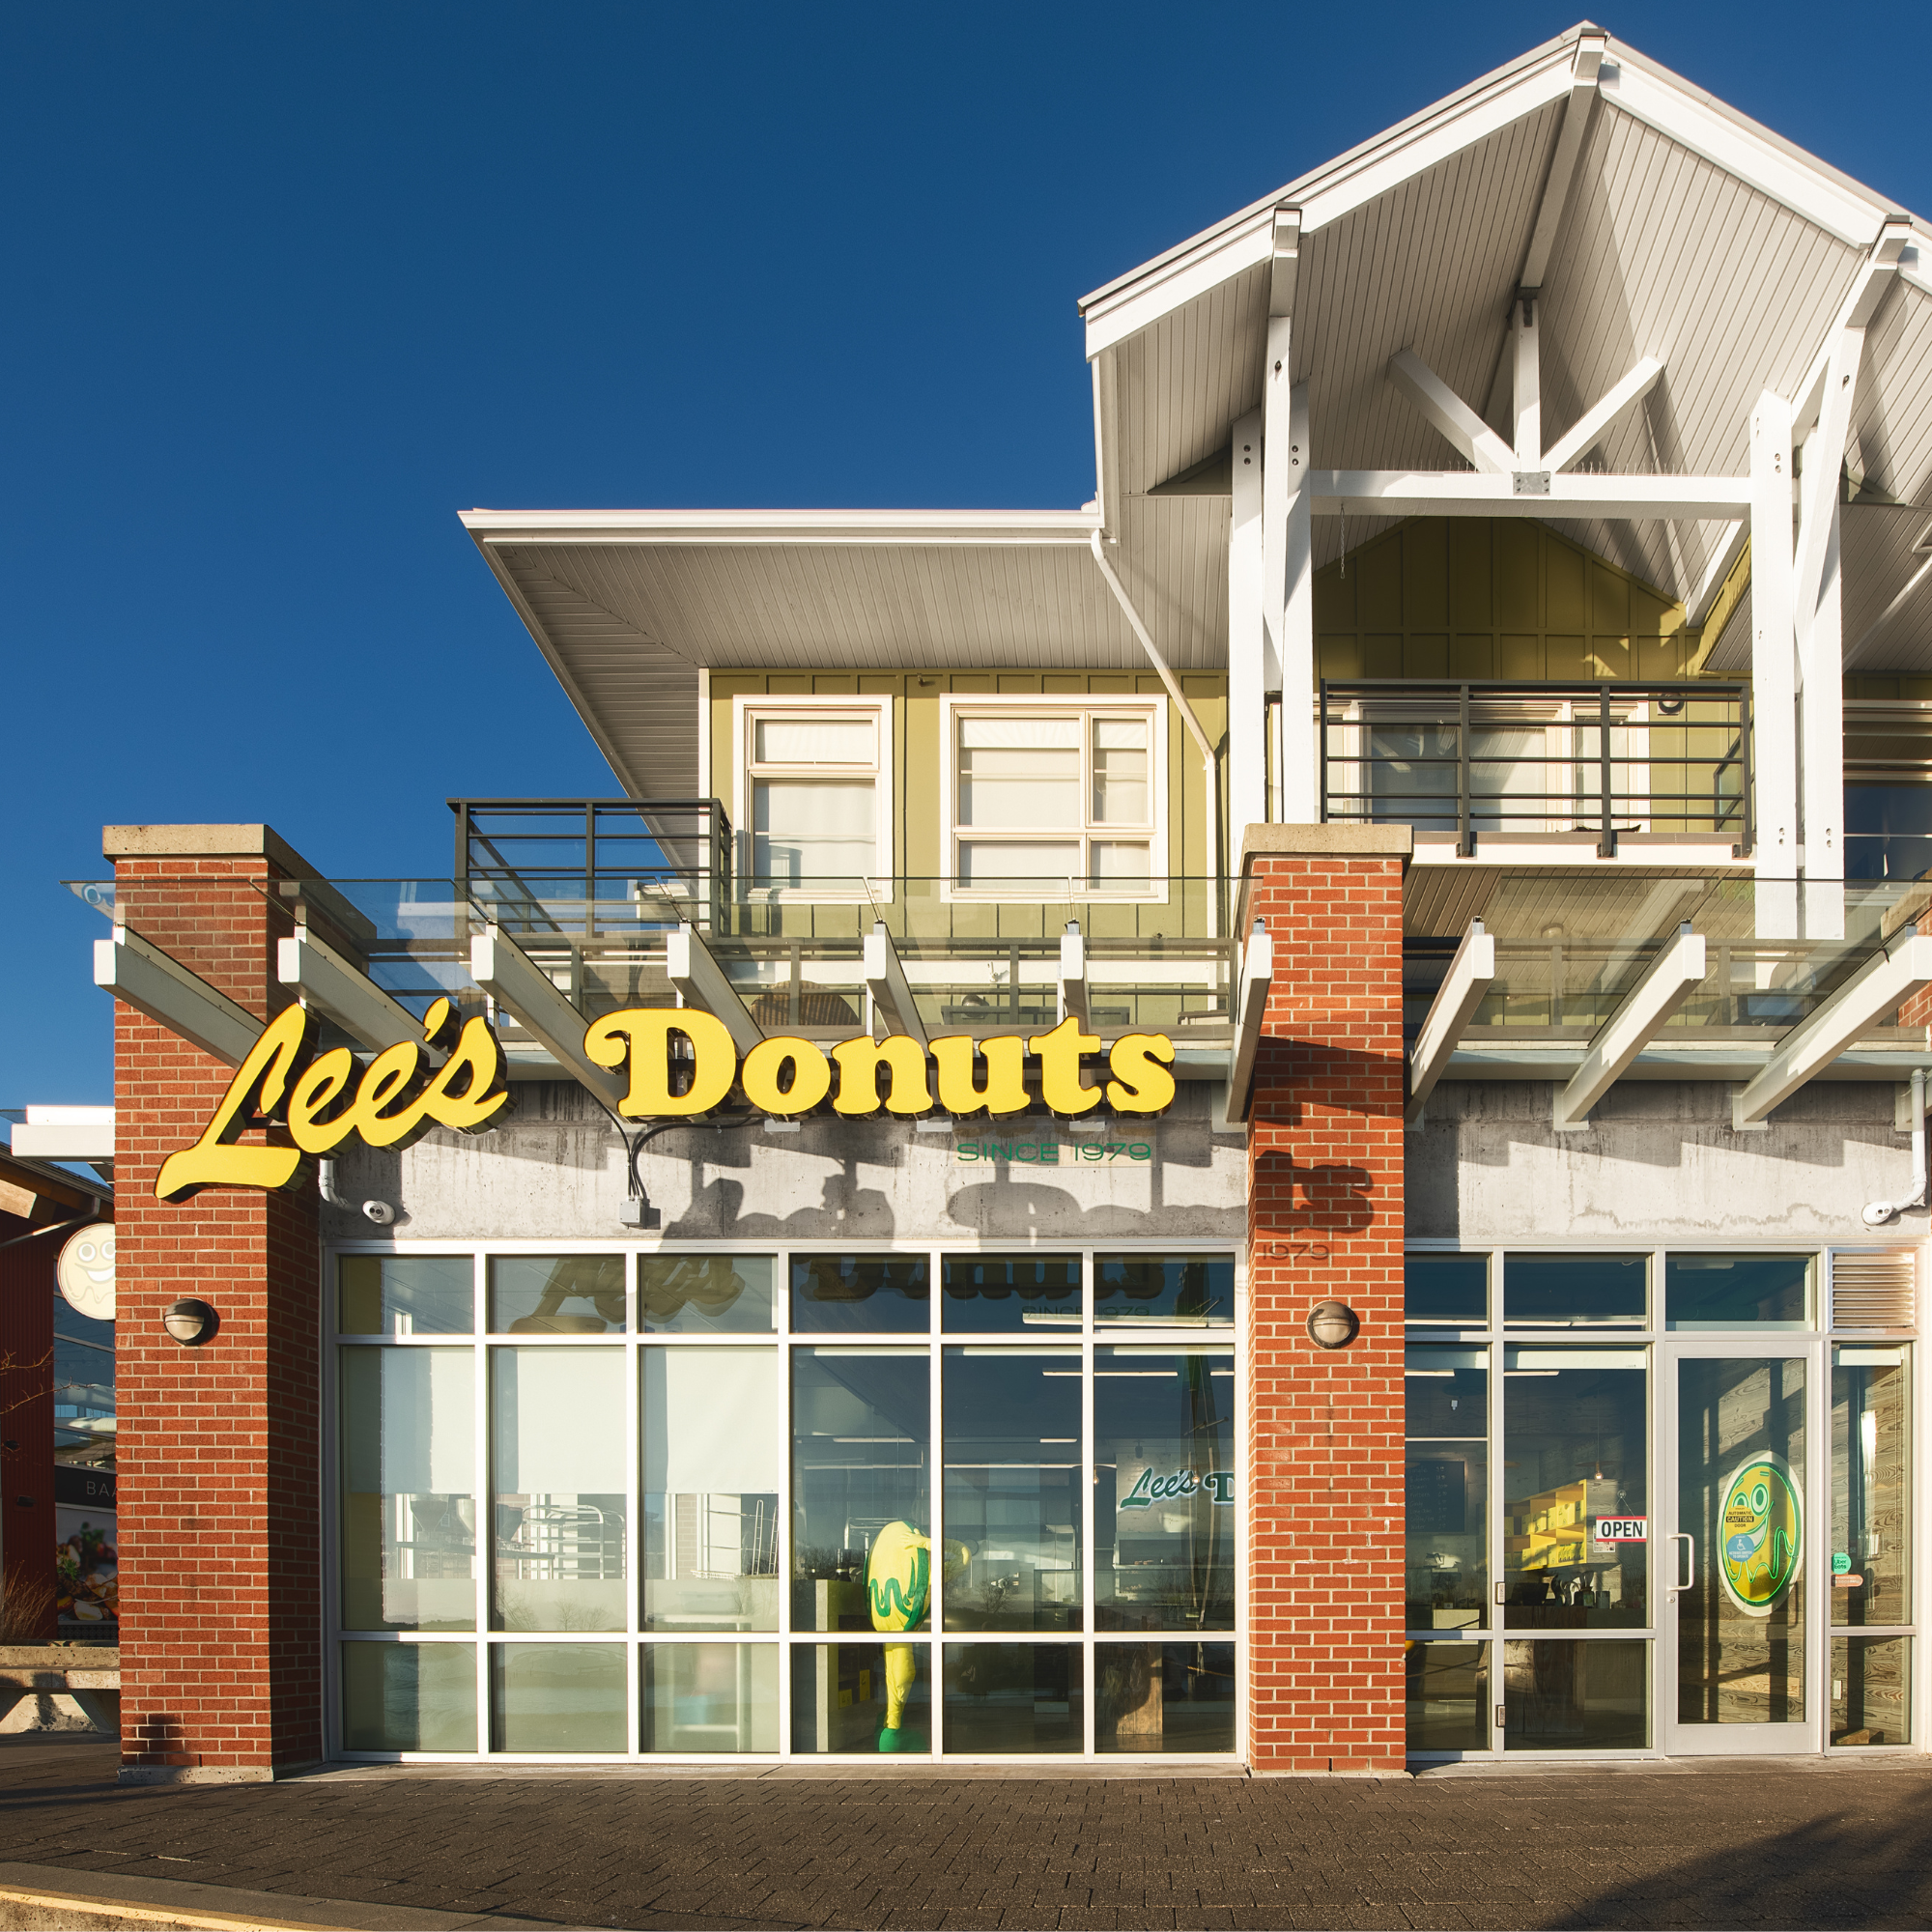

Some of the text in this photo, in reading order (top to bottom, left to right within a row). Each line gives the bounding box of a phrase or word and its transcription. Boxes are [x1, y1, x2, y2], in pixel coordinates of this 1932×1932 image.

[155, 997, 1177, 1201] Lee's Donuts
[956, 1143, 1151, 1162] SINCE 1979
[1120, 1466, 1197, 1509] Lee's
[1601, 1520, 1643, 1538] OPEN
